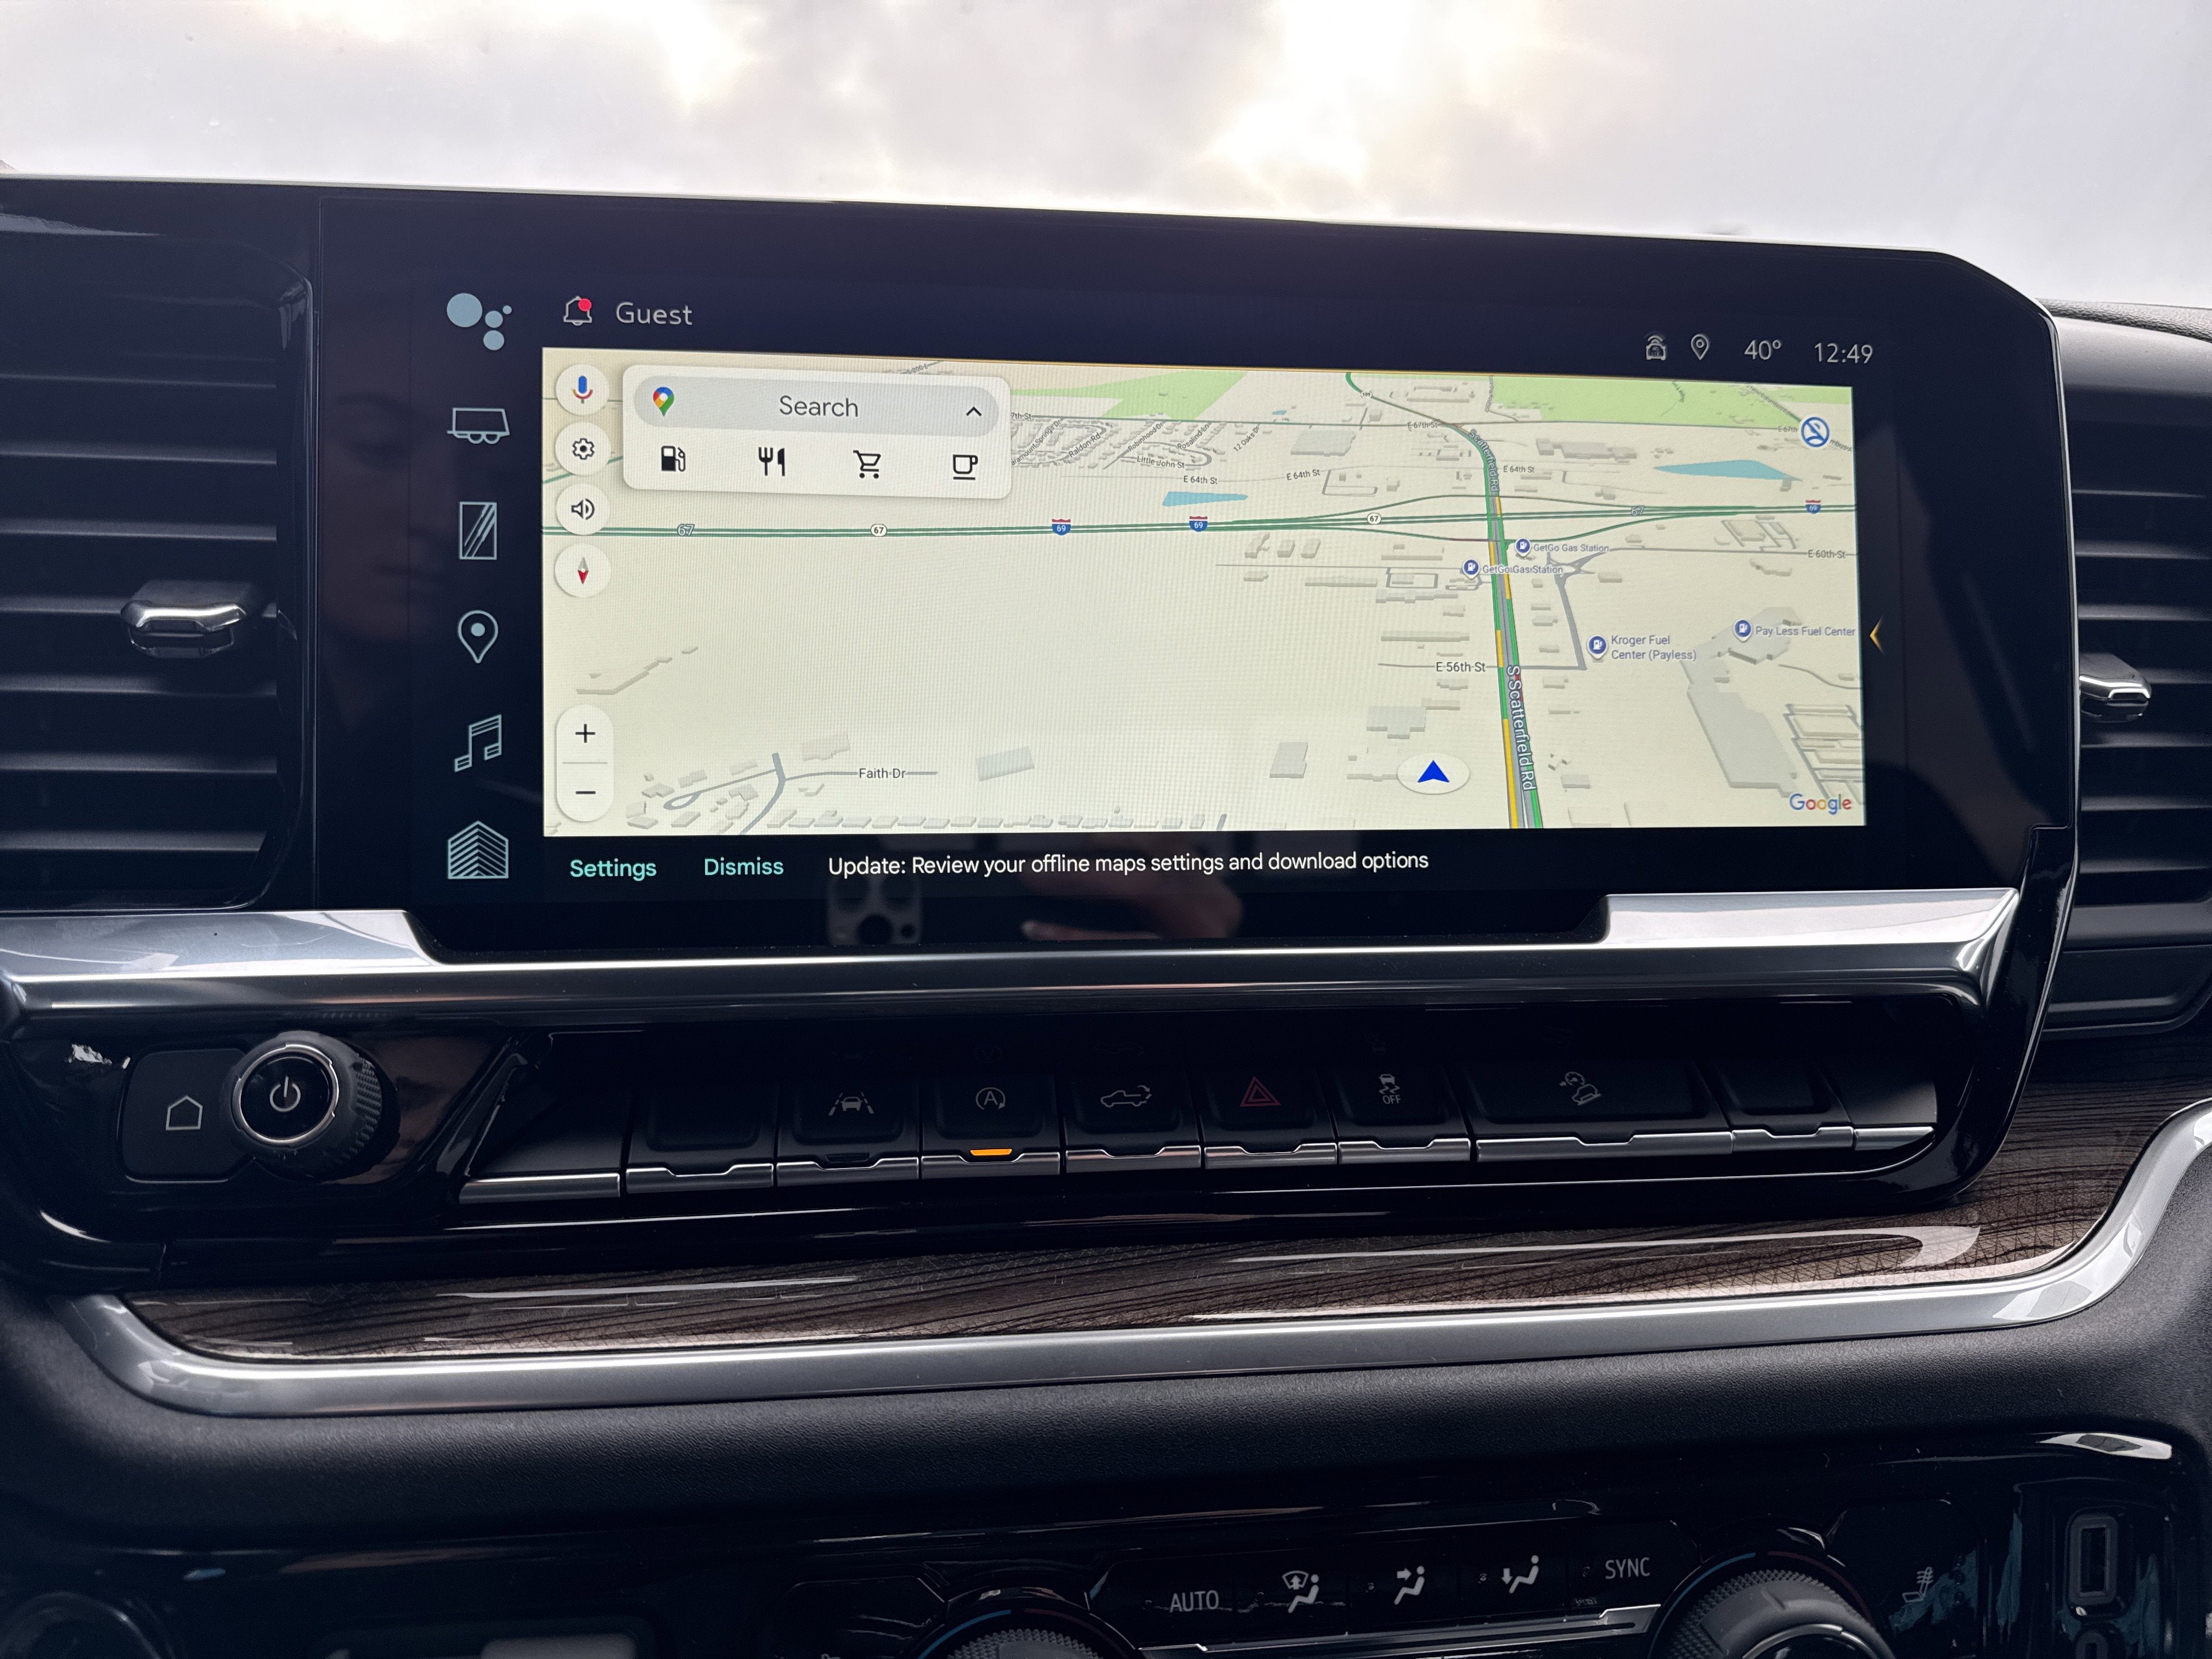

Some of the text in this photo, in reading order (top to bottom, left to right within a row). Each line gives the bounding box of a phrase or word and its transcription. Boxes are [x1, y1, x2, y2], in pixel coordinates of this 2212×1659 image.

[616, 302, 692, 325] Guest
[1744, 339, 1781, 360] 40°
[1814, 342, 1873, 364] 12:49
[780, 395, 858, 417] Search
[1011, 419, 1062, 466] aramount Springs Dr
[1069, 432, 1101, 458] Raldon Rd
[1128, 421, 1164, 452] Robinhood Dr
[1177, 430, 1203, 450] Rosalind
[1233, 425, 1260, 452] 12 Oaks Dr
[1137, 455, 1155, 465] Little
[1156, 459, 1175, 469] John
[1469, 429, 1499, 492] Scatterfield Rd
[1190, 476, 1207, 484] 64th
[1293, 470, 1310, 479] 64th
[1631, 505, 1644, 517] 67
[678, 524, 694, 535] 67
[1534, 544, 1609, 552] GetGo Gas Station
[1815, 550, 1834, 558] 60th
[1837, 550, 1845, 558] St
[1482, 566, 1563, 574] GetGo Gas Station
[1611, 635, 1670, 647] Kroger Fuel
[1756, 626, 1855, 637] Pay Less Fuel Center
[1611, 650, 1696, 662] Center (Payless)
[1436, 662, 1486, 672] E 56th St
[1507, 665, 1537, 791] S Scatterfield Rd
[859, 768, 906, 778] Faith Dr
[1789, 793, 1853, 815] Google
[569, 858, 657, 882] Settings
[704, 856, 785, 876] Dismiss
[828, 851, 1429, 879] Update: Review your offline maps settings and download options
[984, 1091, 998, 1105] A
[1383, 1094, 1401, 1104] OFF
[1605, 1557, 1650, 1579] SYNC
[1170, 1590, 1219, 1613] AUTO
